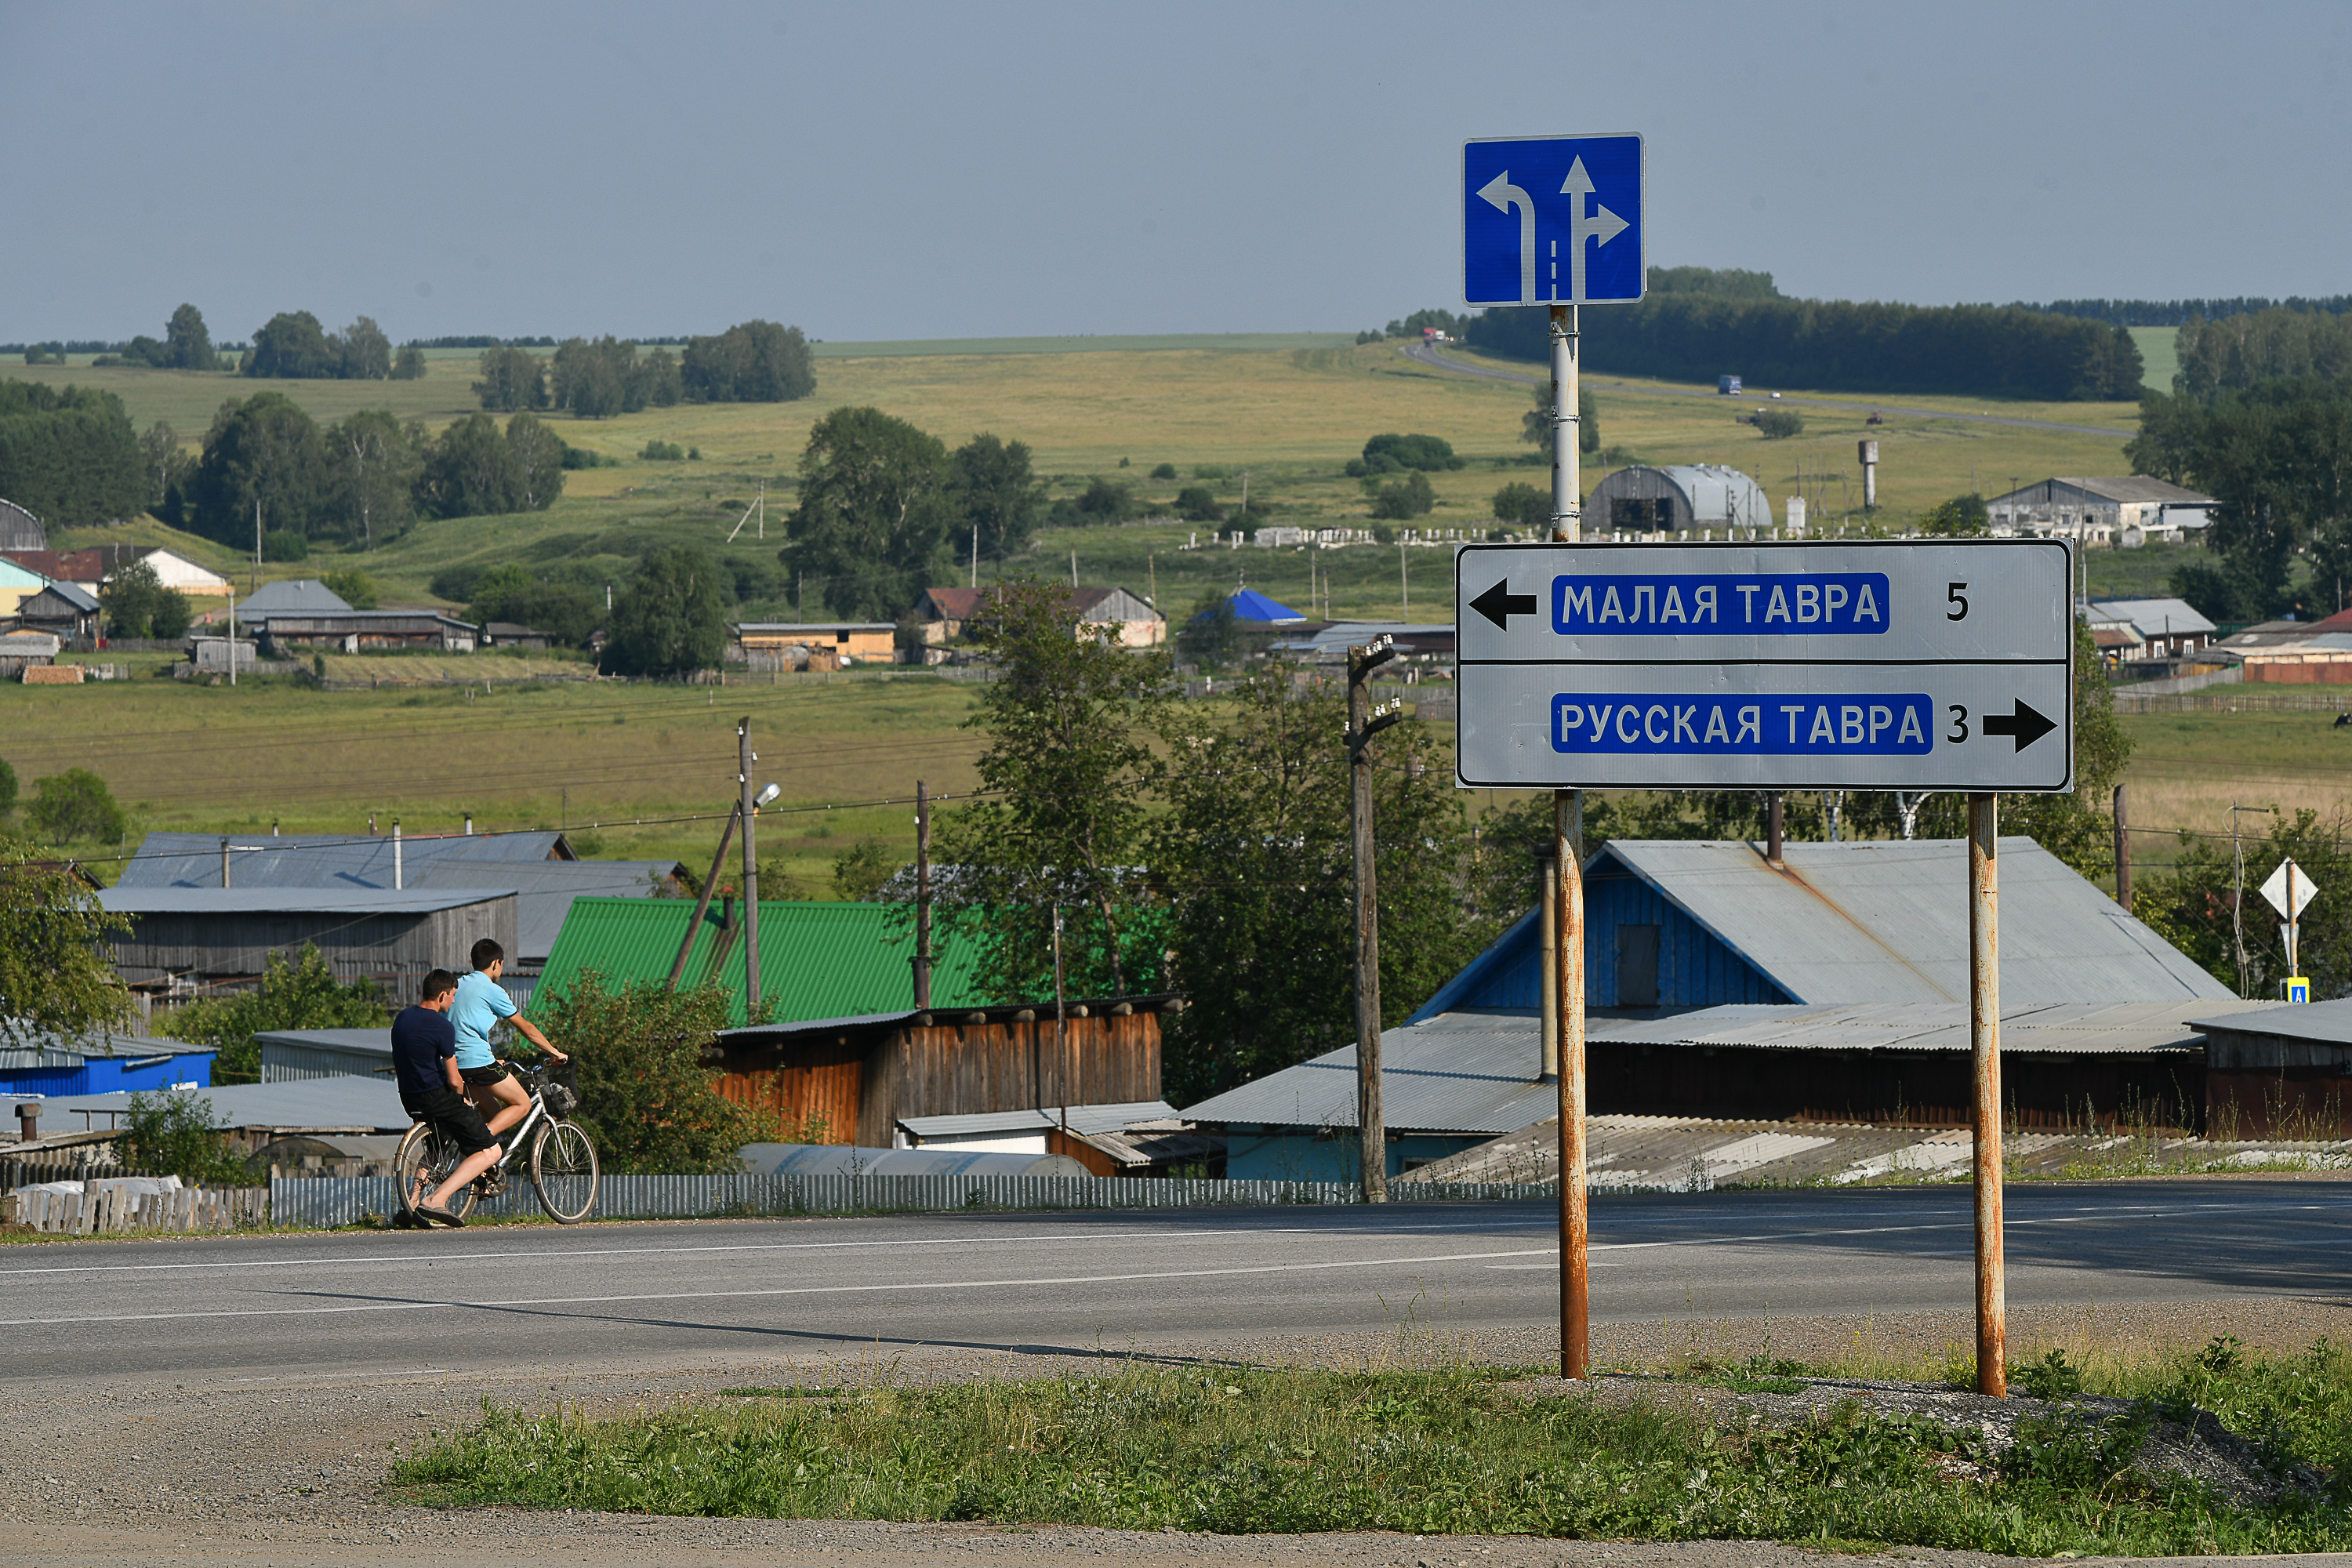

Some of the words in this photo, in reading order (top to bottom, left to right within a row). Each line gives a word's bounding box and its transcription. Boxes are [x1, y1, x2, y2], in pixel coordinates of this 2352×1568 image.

[1562, 585, 1717, 624] МАЛАЯ
[1736, 584, 1880, 623] ТАВРА
[1946, 582, 1969, 622] 5
[1561, 704, 1760, 744] РУССКАЯ
[1780, 706, 1925, 744] ТАВРА
[1947, 704, 1969, 744] 3
